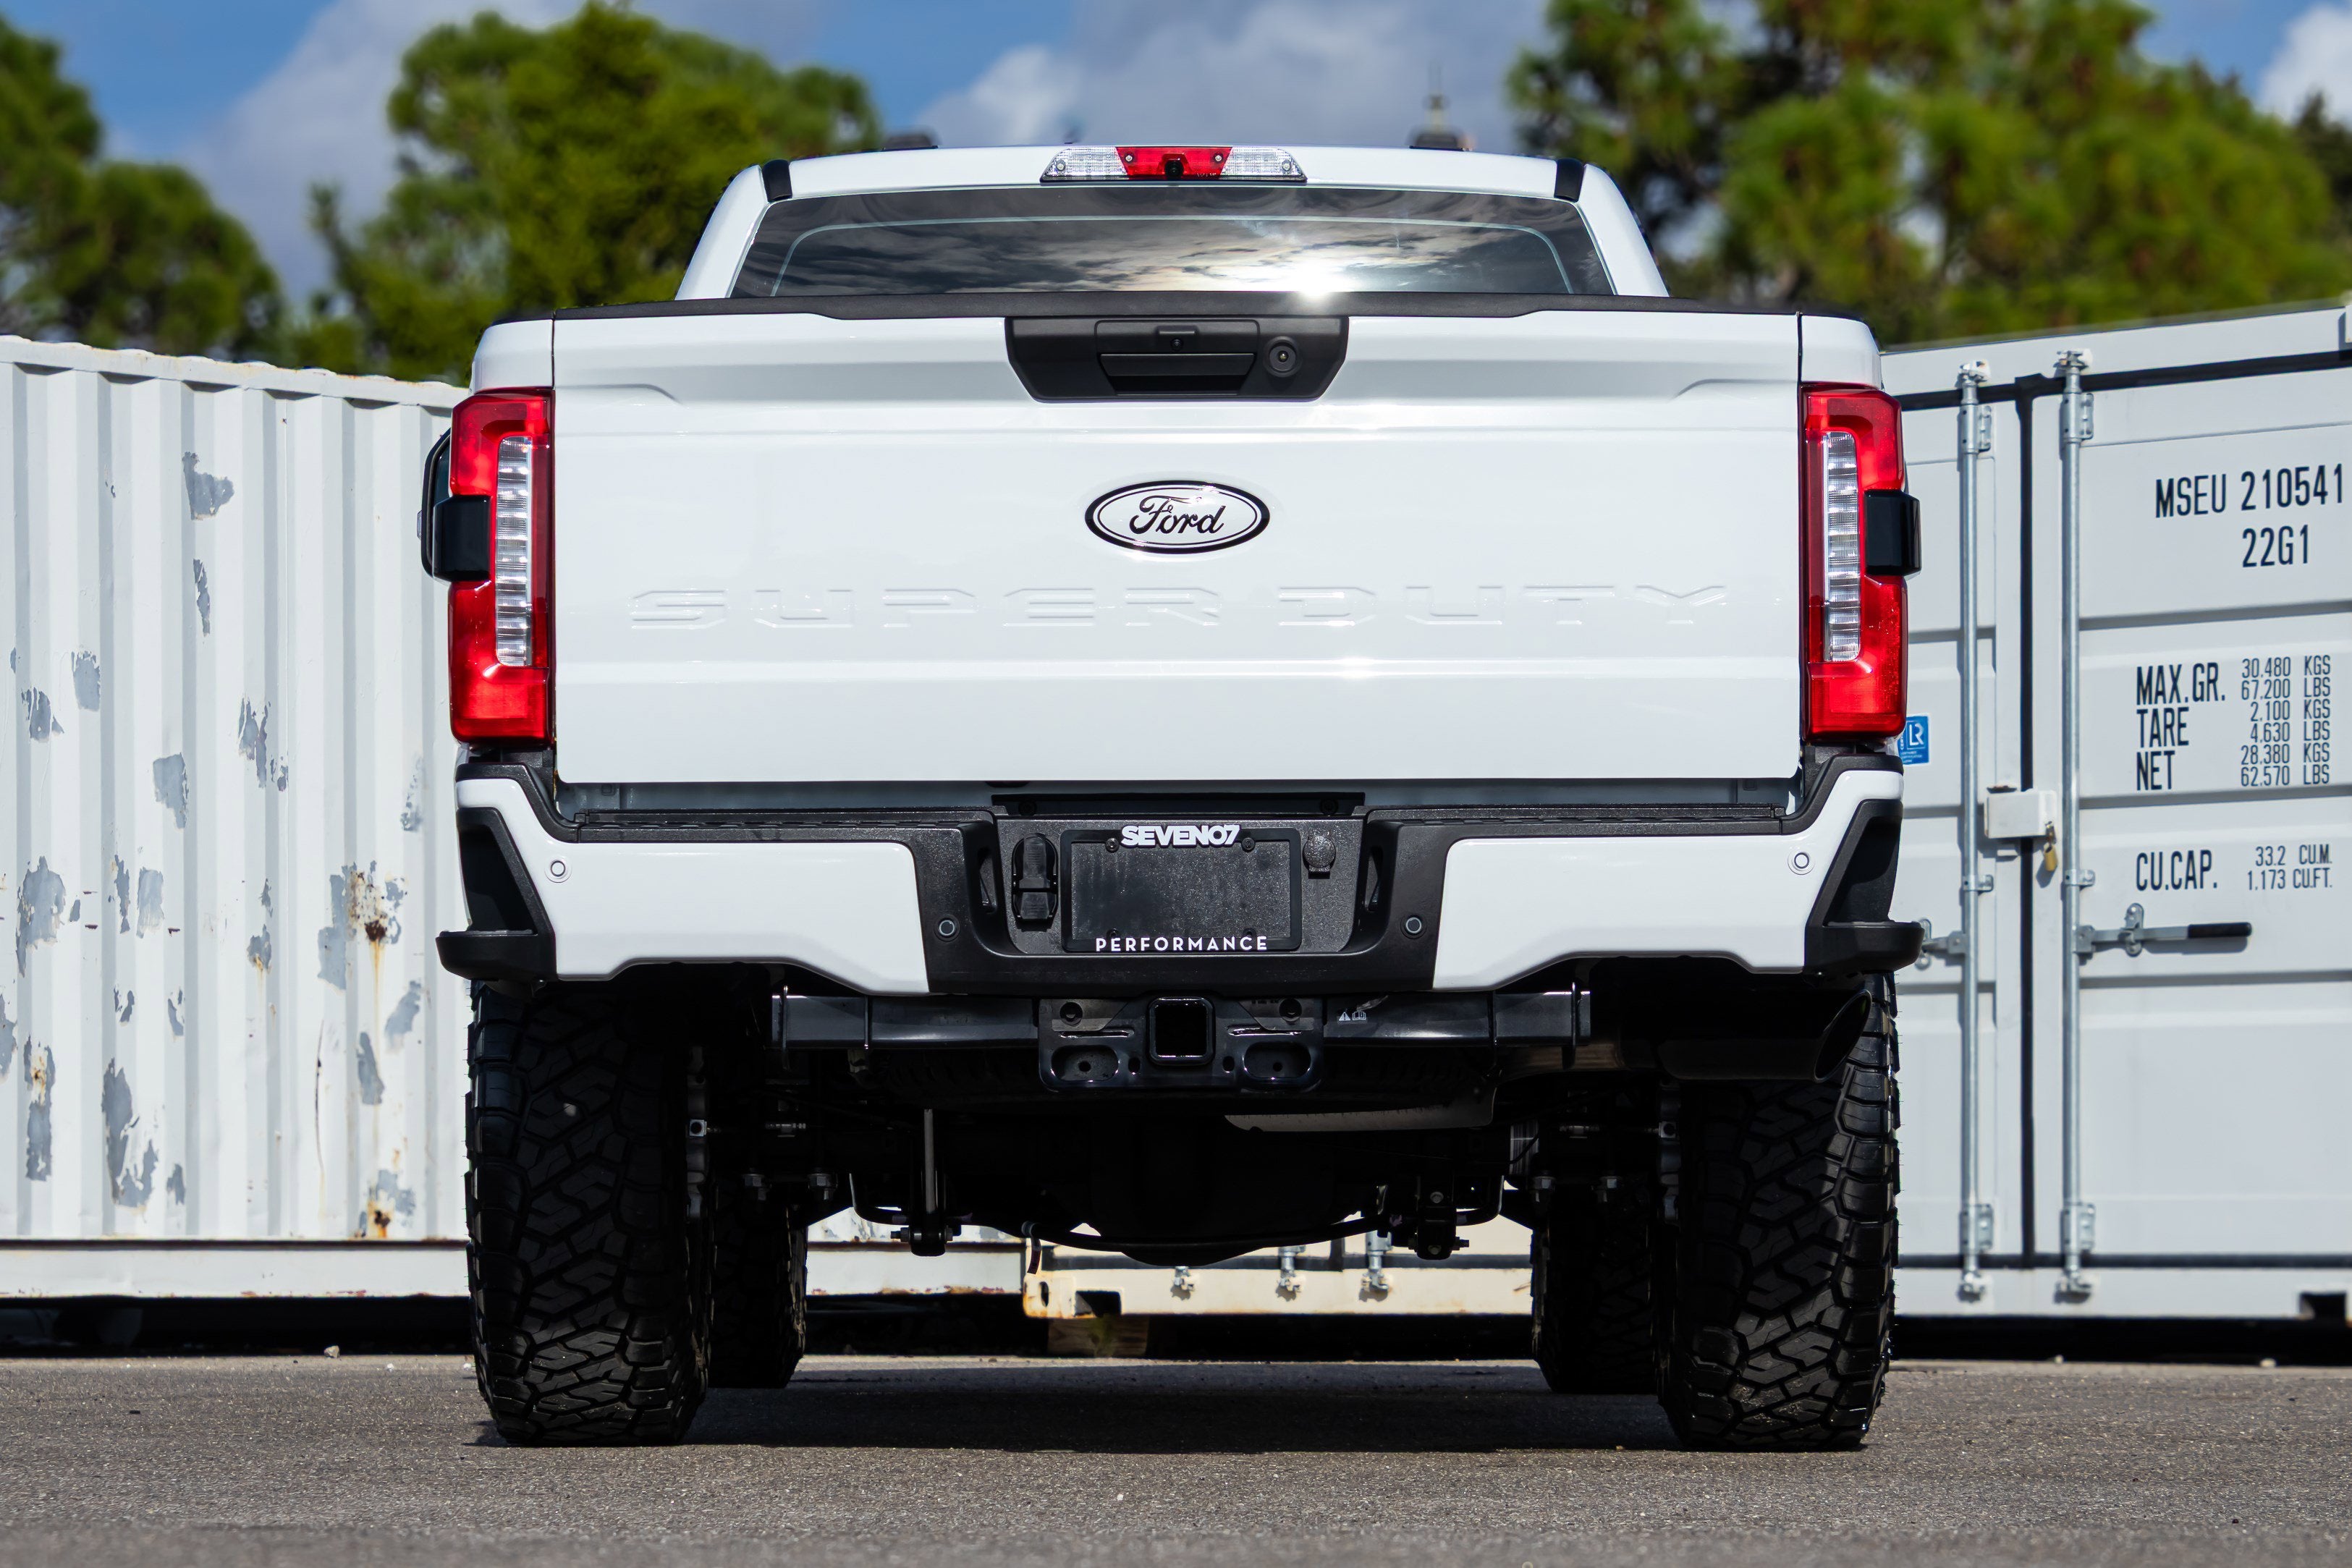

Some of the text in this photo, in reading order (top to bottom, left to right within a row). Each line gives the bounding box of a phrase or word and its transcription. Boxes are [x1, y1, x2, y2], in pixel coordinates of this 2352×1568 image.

[2155, 463, 2343, 518] MSEU 210541
[1129, 495, 1226, 534] Ford
[2242, 524, 2309, 568] 22G1
[630, 585, 1725, 629] SUPER DUTY
[2304, 655, 2331, 676] KGS
[2136, 662, 2226, 705] MAX.GR.
[2304, 677, 2331, 698] LBS
[2304, 698, 2331, 719] KGS
[2136, 706, 2190, 748] TARE
[2304, 720, 2330, 742] LBS
[2304, 742, 2330, 763] KGS
[2136, 750, 2176, 791] NET
[2303, 763, 2330, 785] LBS
[2136, 849, 2218, 891] CU.CAP.
[2255, 845, 2286, 867] 33.2
[1096, 936, 1267, 952] PERFORMANCE
